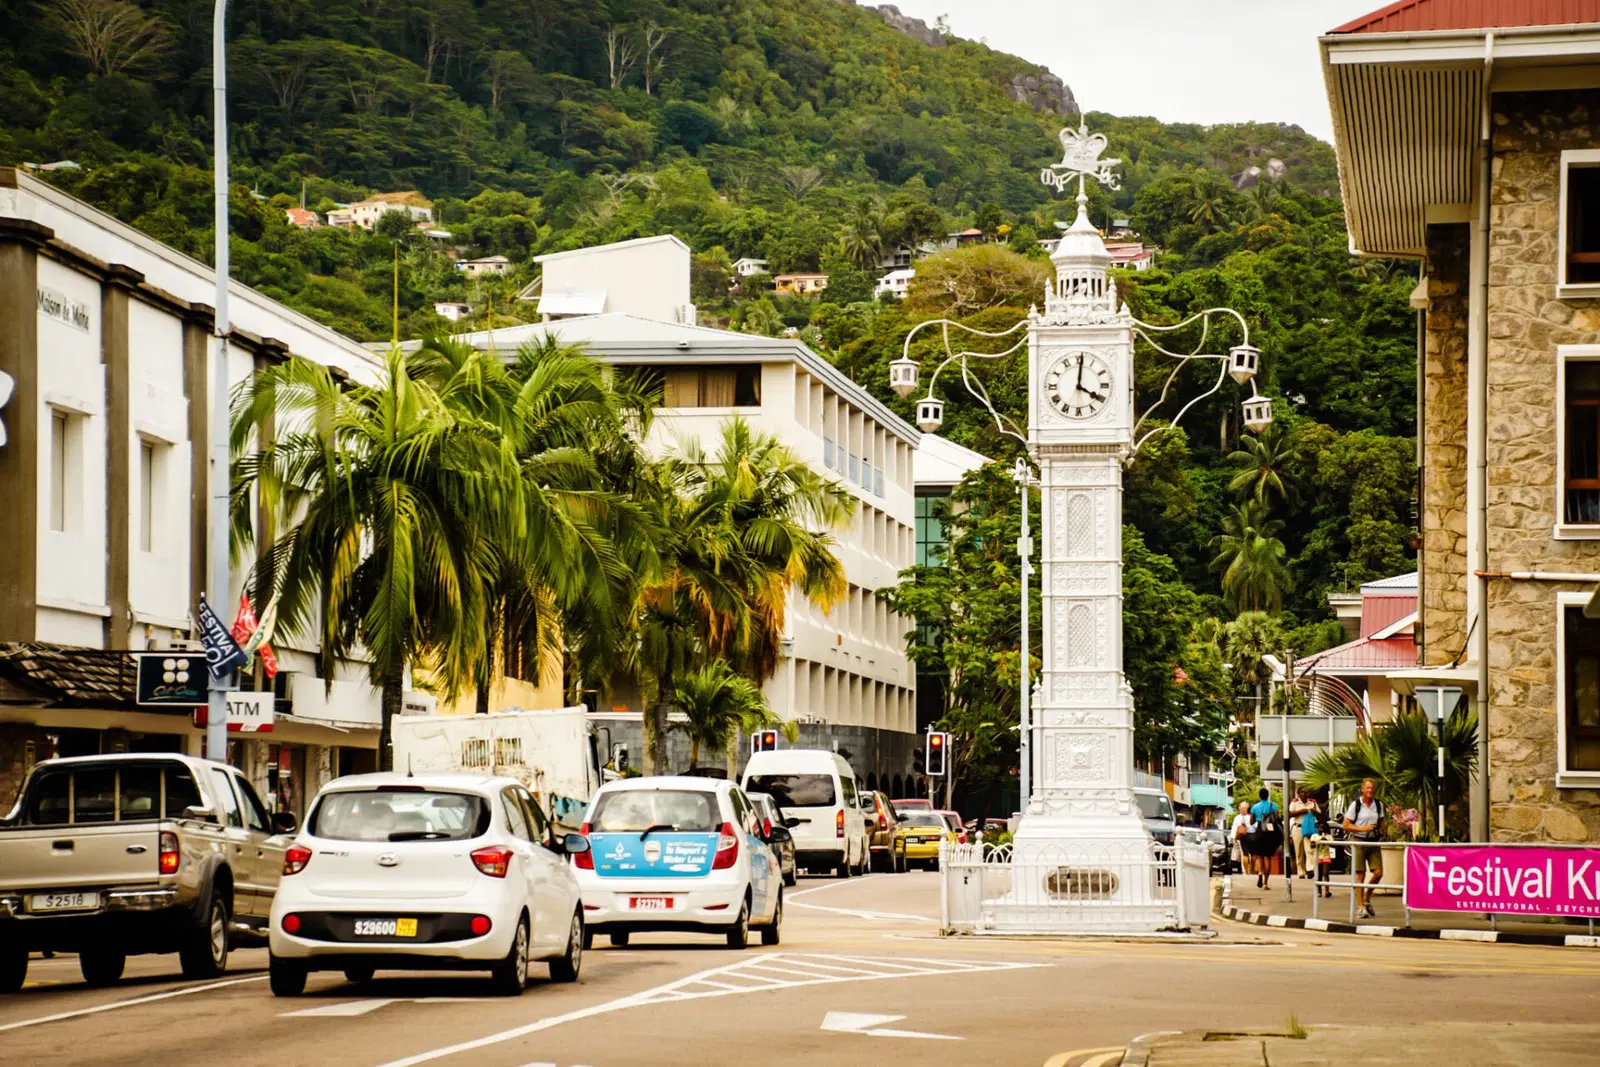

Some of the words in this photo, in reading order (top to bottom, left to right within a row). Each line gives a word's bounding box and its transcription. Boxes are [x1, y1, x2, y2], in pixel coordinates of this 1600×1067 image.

[226, 702, 260, 716] ATM
[1427, 855, 1552, 898] Festival
[354, 920, 396, 935] S29600
